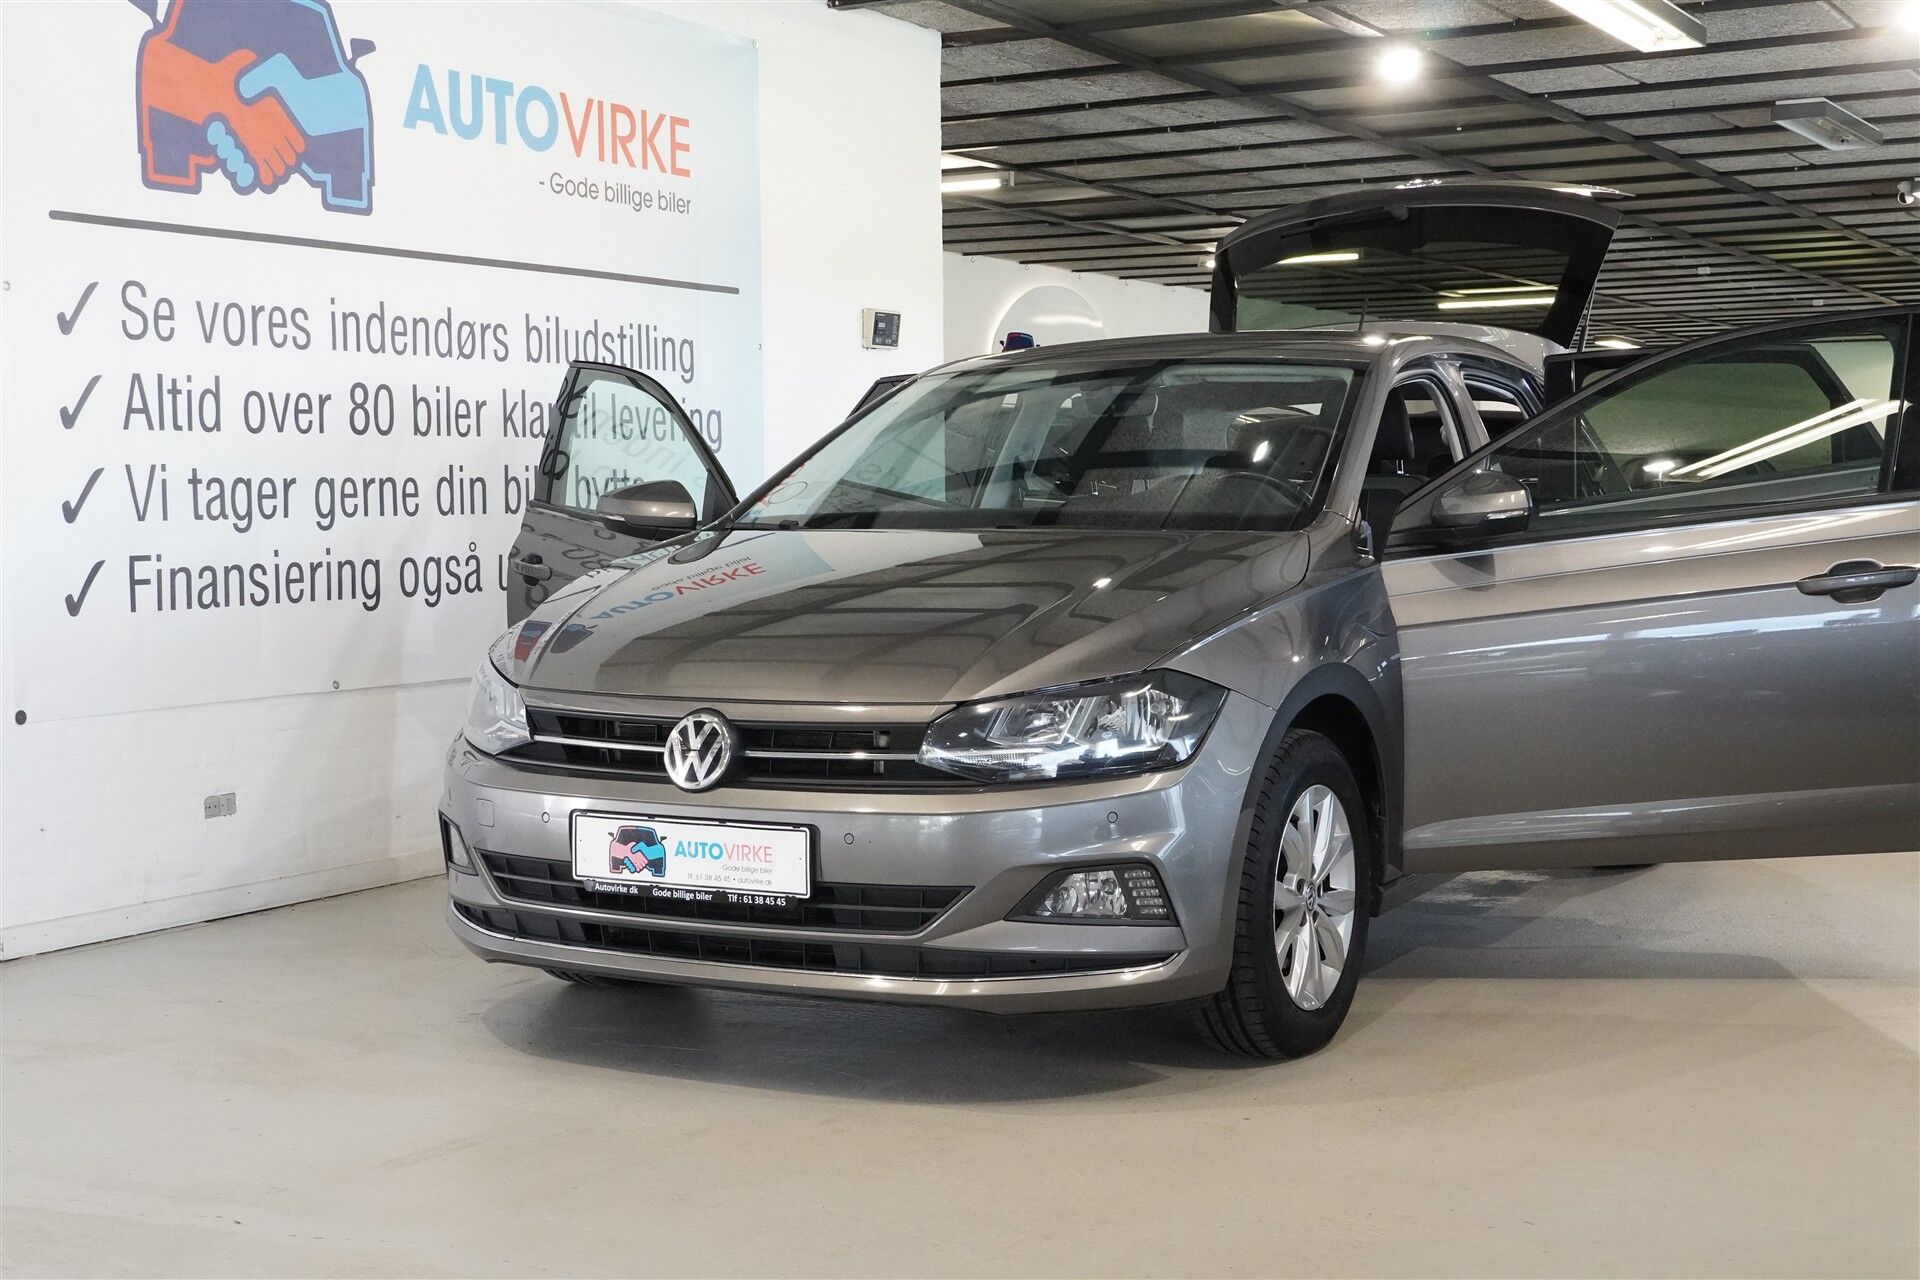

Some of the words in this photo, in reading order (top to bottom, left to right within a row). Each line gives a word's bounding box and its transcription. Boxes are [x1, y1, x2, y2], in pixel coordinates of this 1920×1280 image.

[403, 63, 692, 178] AUTOVIRKE
[549, 171, 599, 201] Gode
[604, 180, 654, 213] billige
[657, 189, 692, 215] biler
[120, 279, 176, 343] Se
[196, 300, 311, 351] vores
[330, 298, 510, 363] indendørs
[525, 313, 696, 384] biludstilling
[122, 372, 222, 434] Altid
[243, 390, 331, 435] over
[348, 381, 395, 437] 80
[411, 384, 488, 438] biler
[125, 464, 169, 522] Vi
[187, 467, 297, 534] tager
[315, 476, 420, 532] gerne
[436, 464, 488, 517] din
[128, 550, 381, 613] Finansiering
[399, 542, 483, 609] også
[674, 840, 773, 863] AUTOVIRKE
[594, 882, 628, 893] Autovirke
[652, 888, 672, 897] Gode
[672, 889, 695, 901] billige
[695, 891, 713, 901] biler
[727, 893, 738, 903] Tlf
[743, 895, 752, 904] 61
[754, 896, 764, 905] 38
[765, 897, 775, 906] 45
[776, 898, 786, 906] 45
